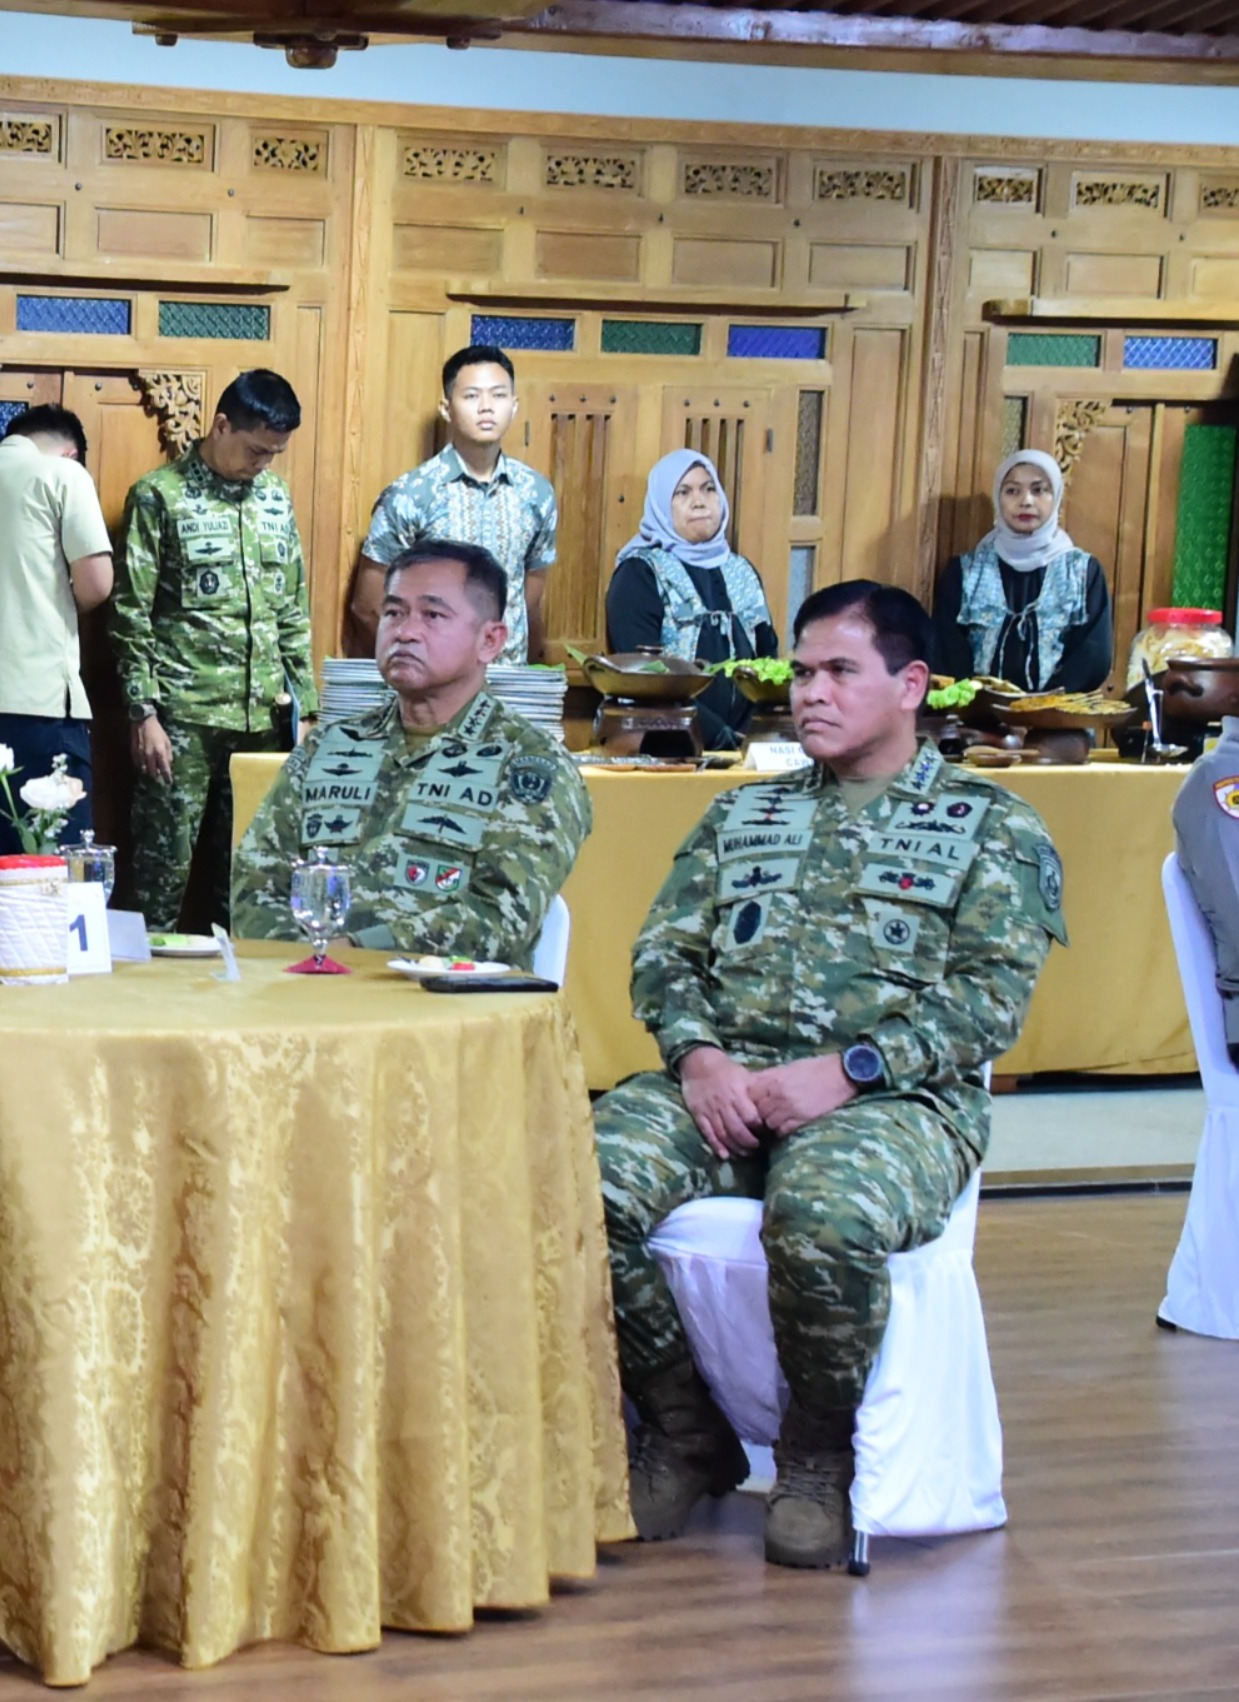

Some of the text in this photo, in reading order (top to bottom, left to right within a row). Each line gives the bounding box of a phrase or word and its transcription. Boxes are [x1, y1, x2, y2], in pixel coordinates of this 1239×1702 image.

[262, 521, 278, 531] TNI
[769, 746, 795, 755] NASI
[305, 785, 371, 803] MARULI
[417, 783, 493, 806] TNI AD
[723, 833, 803, 853] MUHAMMAD ALI
[880, 837, 960, 860] TNI AL
[69, 914, 88, 952] 1
